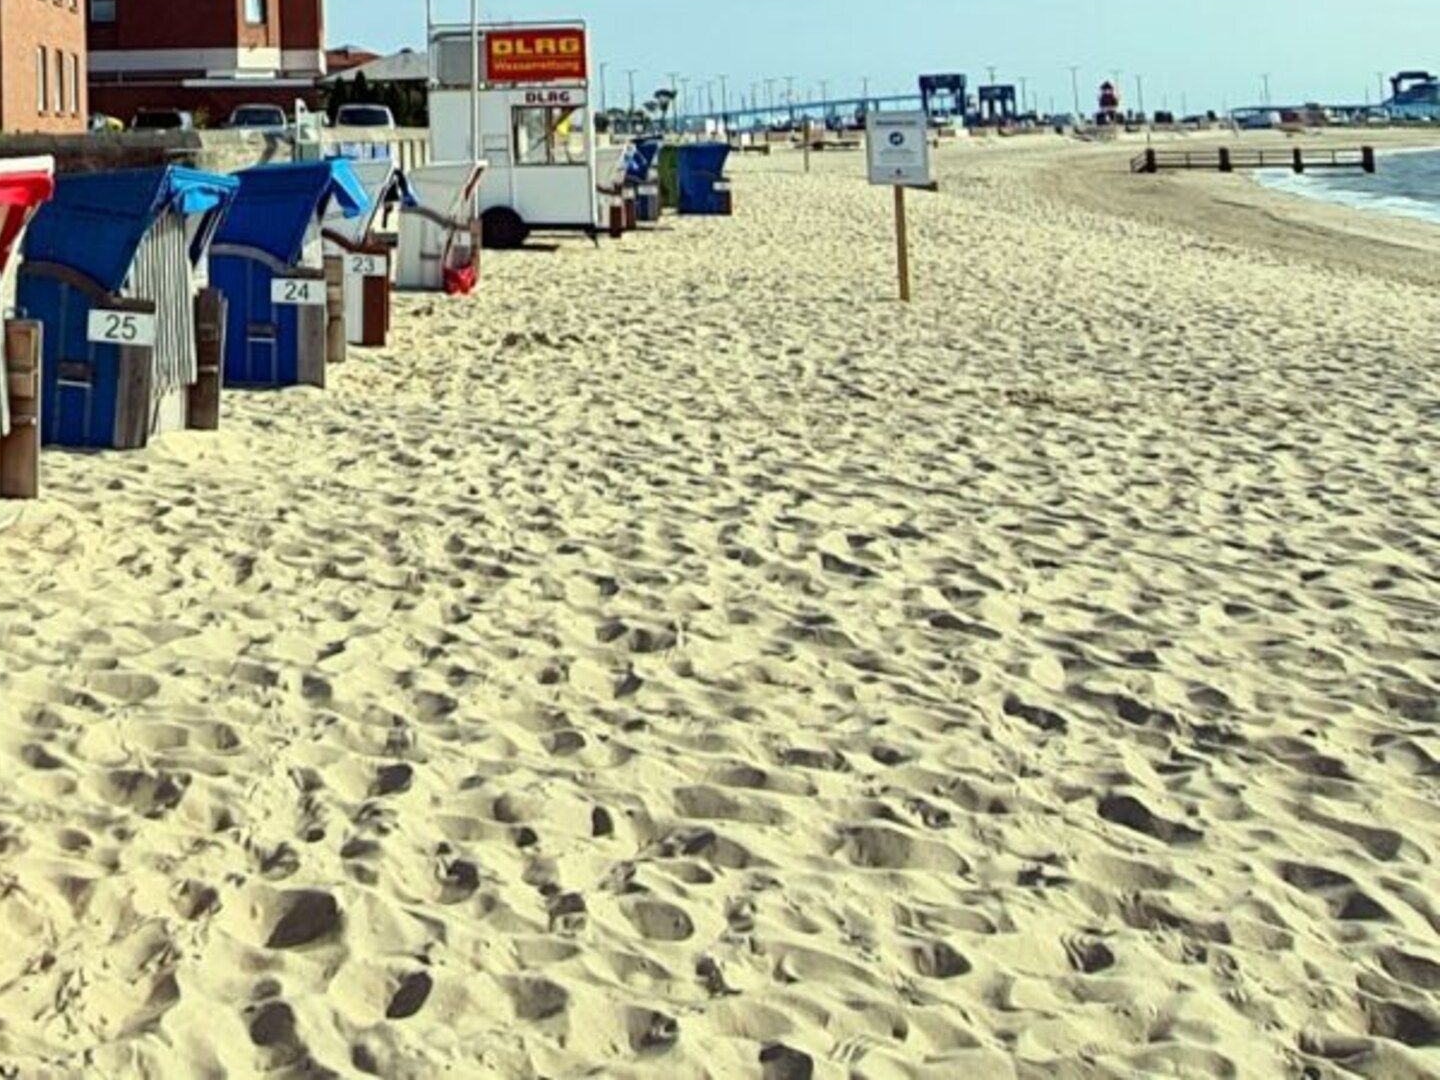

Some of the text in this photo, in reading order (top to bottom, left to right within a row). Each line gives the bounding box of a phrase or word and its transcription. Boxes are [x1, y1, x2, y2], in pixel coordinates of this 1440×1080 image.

[491, 37, 580, 55] DLRG
[525, 91, 570, 103] DLRG
[352, 257, 375, 273] 23
[284, 281, 310, 301] 24
[104, 314, 137, 340] 25
